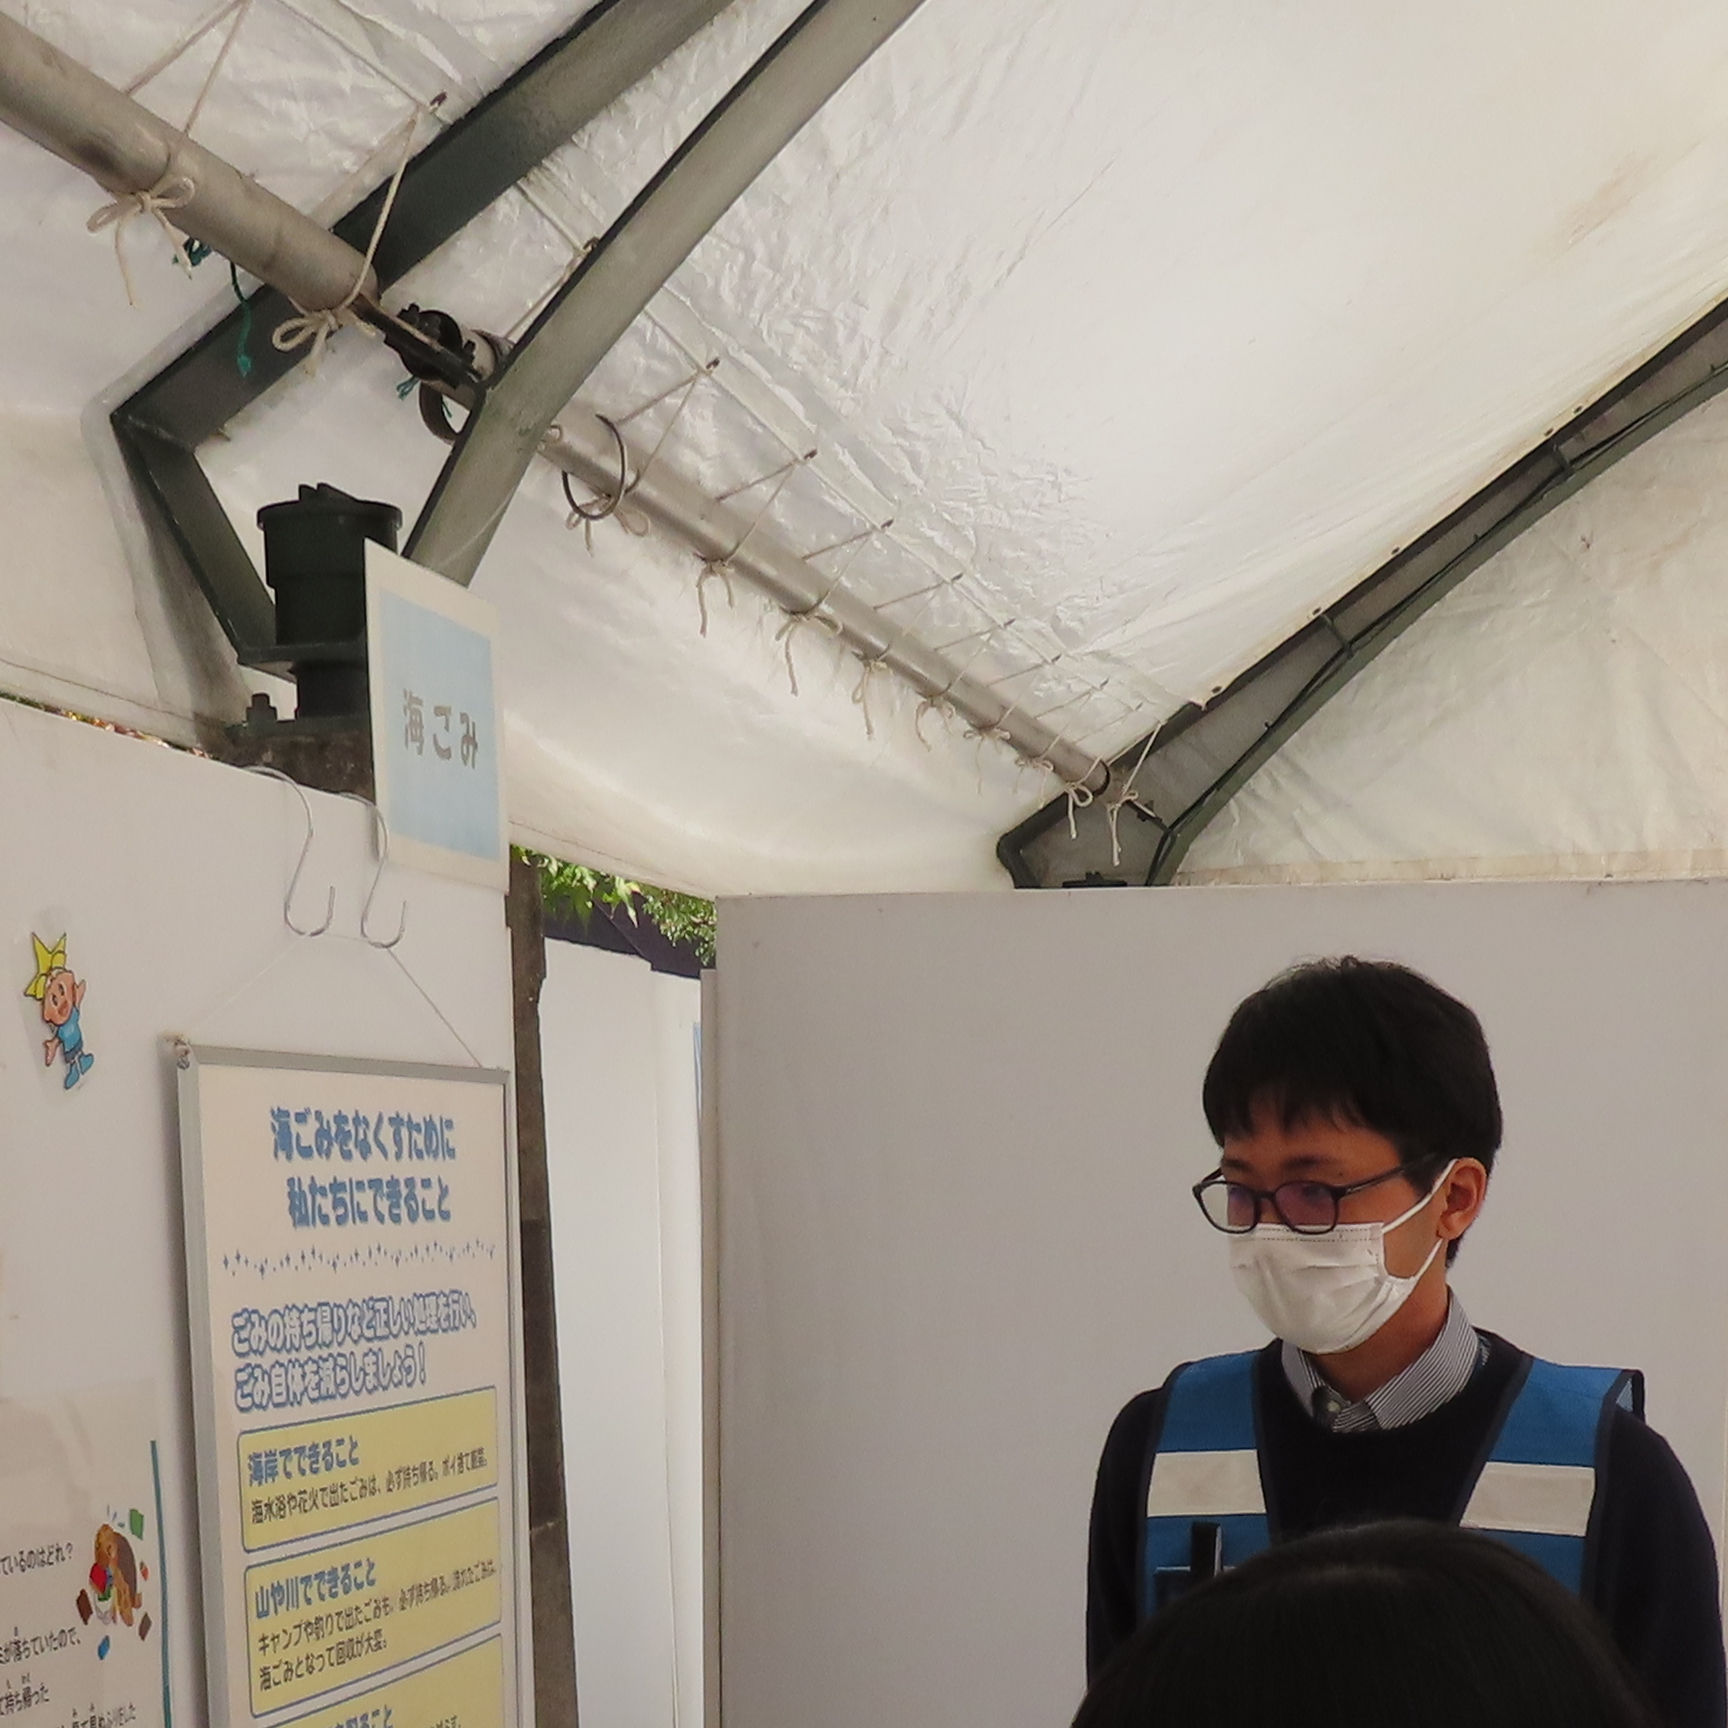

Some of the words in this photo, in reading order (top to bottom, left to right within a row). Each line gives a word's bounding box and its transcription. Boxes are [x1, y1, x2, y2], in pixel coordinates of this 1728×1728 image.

[403, 688, 478, 769] 海ごみ
[271, 1106, 456, 1162] 海ごみをなくすために
[287, 1175, 452, 1228] 私たちにできること
[248, 1435, 360, 1487] 海岸でできること
[255, 1557, 377, 1620] 山や川でできること
[259, 1627, 388, 1692] 海ごみとなって回収が大変。
